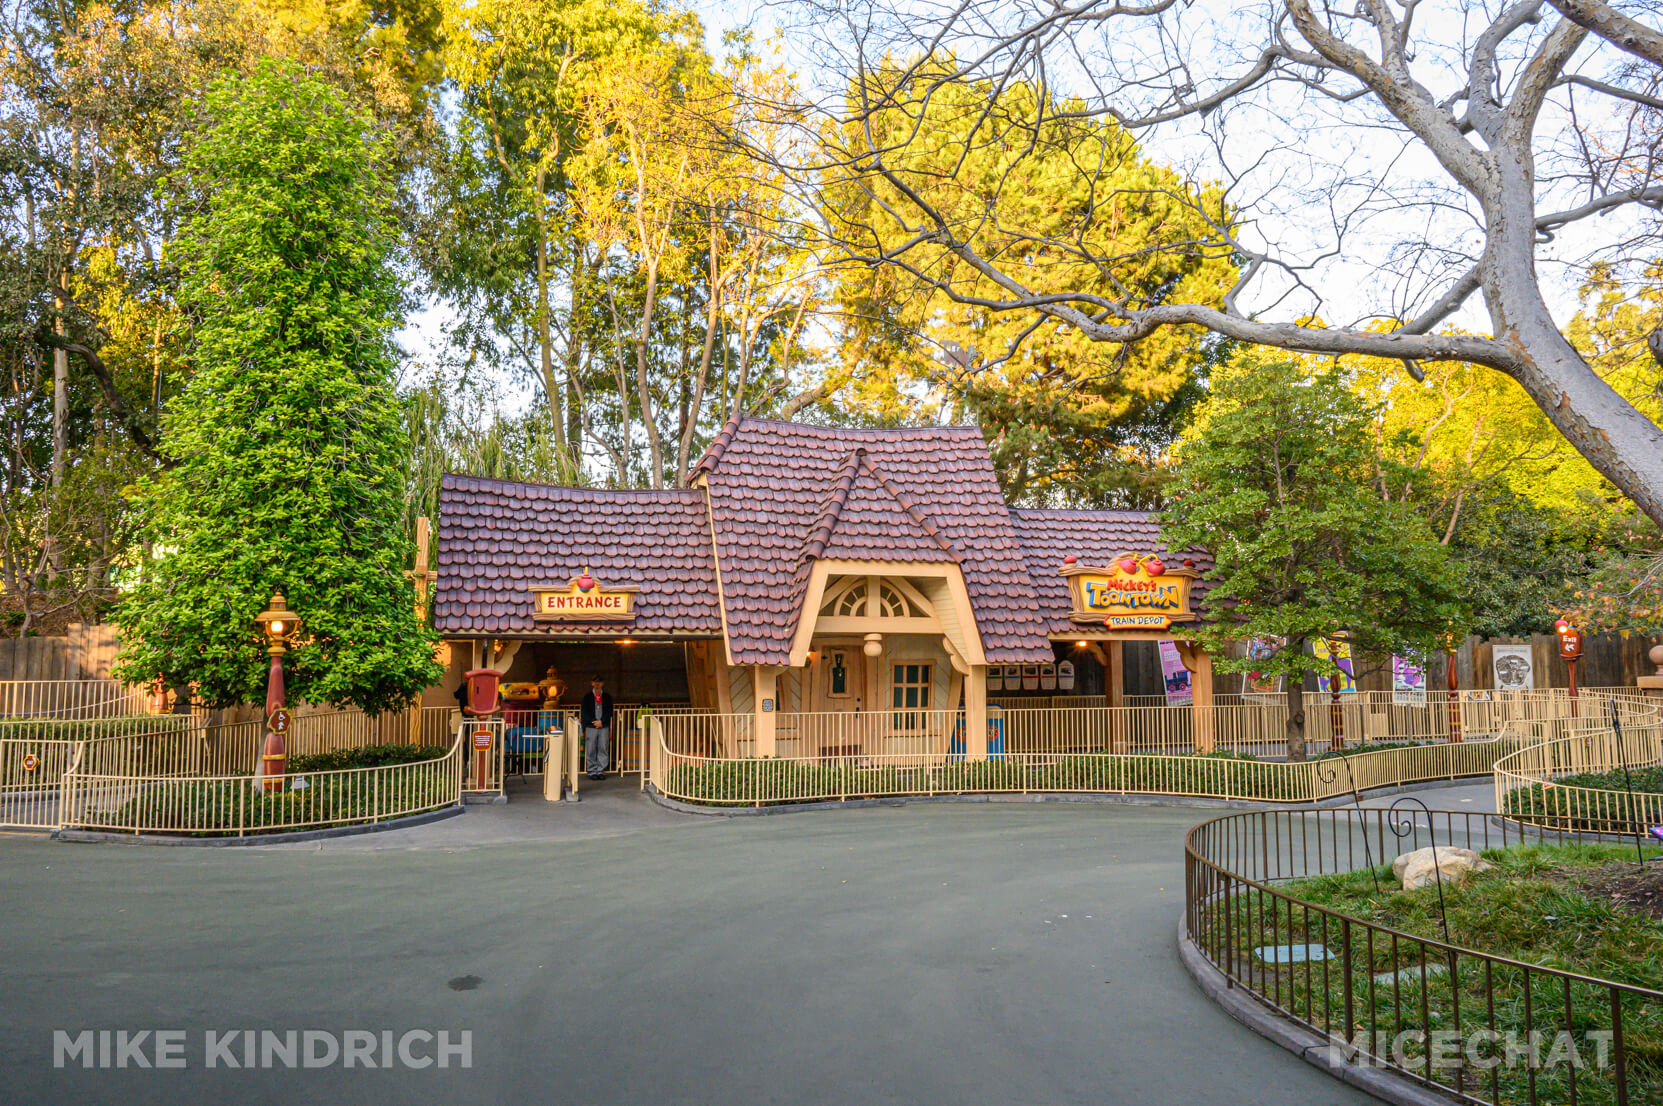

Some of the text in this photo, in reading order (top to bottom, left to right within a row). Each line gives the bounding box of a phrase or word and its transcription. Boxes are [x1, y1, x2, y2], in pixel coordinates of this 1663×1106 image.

[1086, 582, 1179, 608] TOONTOWN
[547, 596, 621, 608] ENTRANCE
[1111, 616, 1165, 625] TRAIN DEPOT
